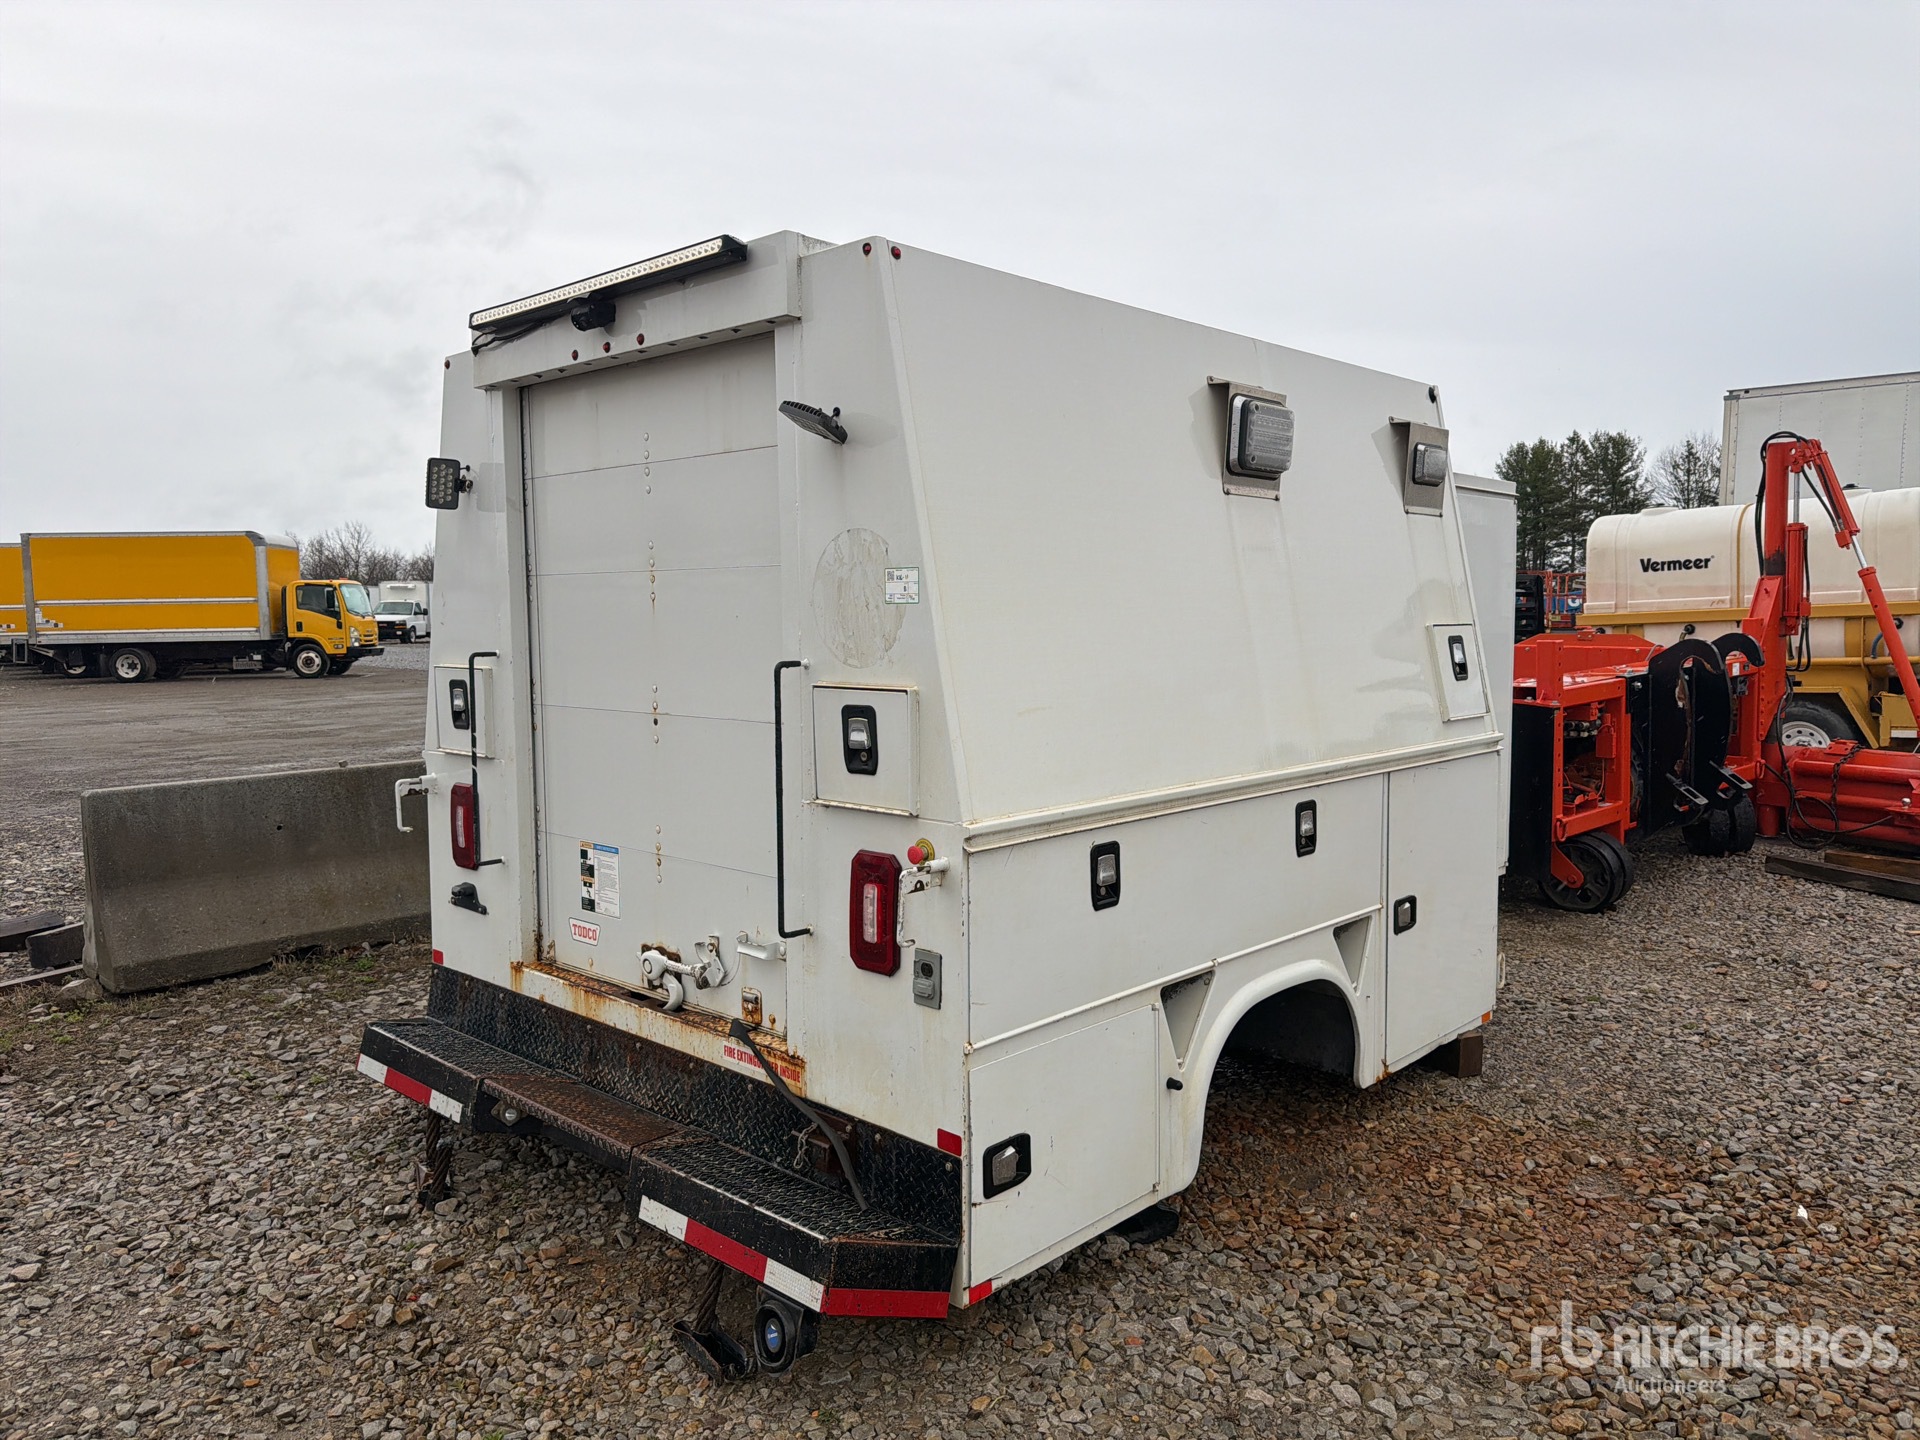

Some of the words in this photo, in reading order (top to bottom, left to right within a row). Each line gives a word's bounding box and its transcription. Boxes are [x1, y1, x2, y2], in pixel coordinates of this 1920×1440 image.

[1640, 558, 1711, 573] Vermeer
[572, 923, 597, 942] TODCO
[723, 1045, 736, 1060] FIRE
[780, 1065, 801, 1084] INSIDE
